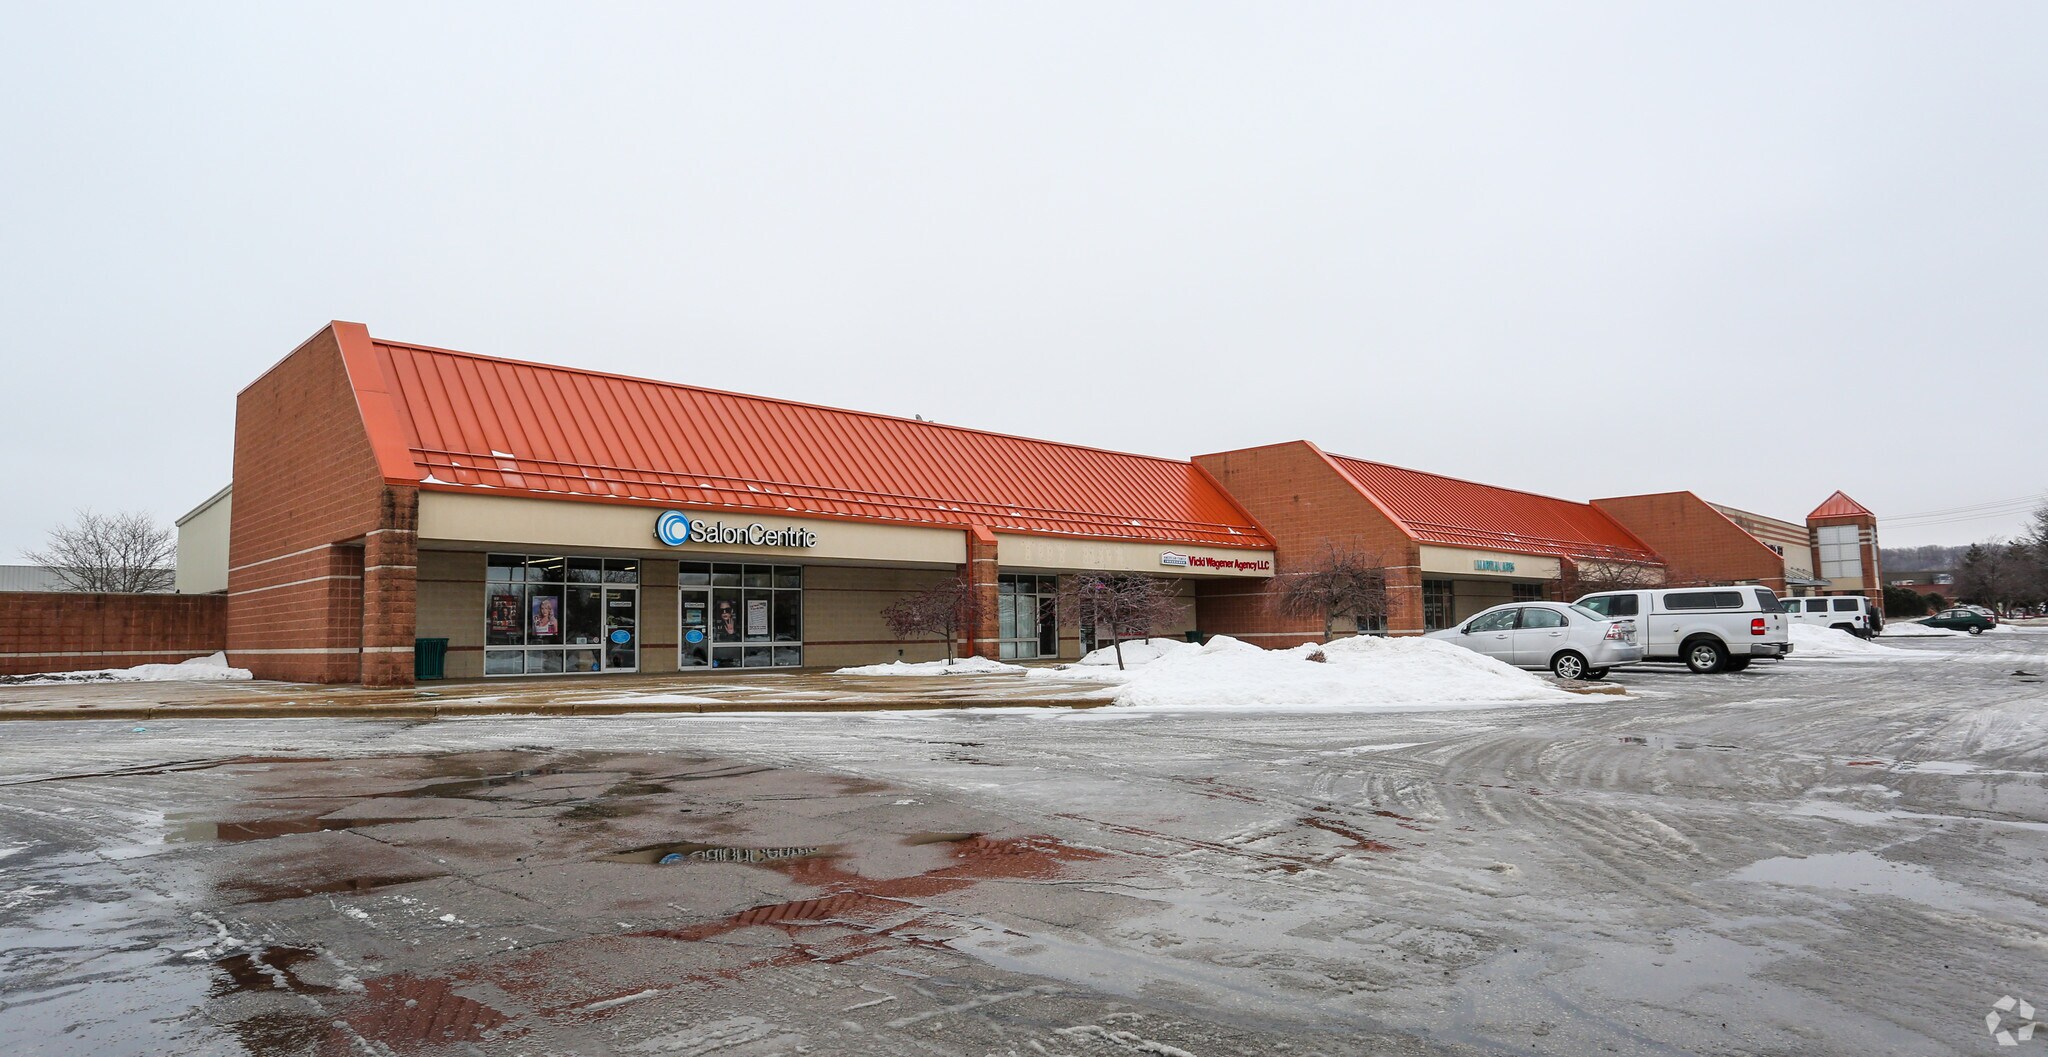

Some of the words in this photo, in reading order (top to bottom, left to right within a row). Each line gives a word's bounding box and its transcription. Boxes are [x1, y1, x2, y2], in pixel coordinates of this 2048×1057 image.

[690, 519, 818, 548] SalonCentric
[1188, 556, 1205, 566] Vicki
[1206, 557, 1234, 570] Wagener
[1234, 559, 1257, 571] Agency
[1257, 560, 1269, 570] LLC
